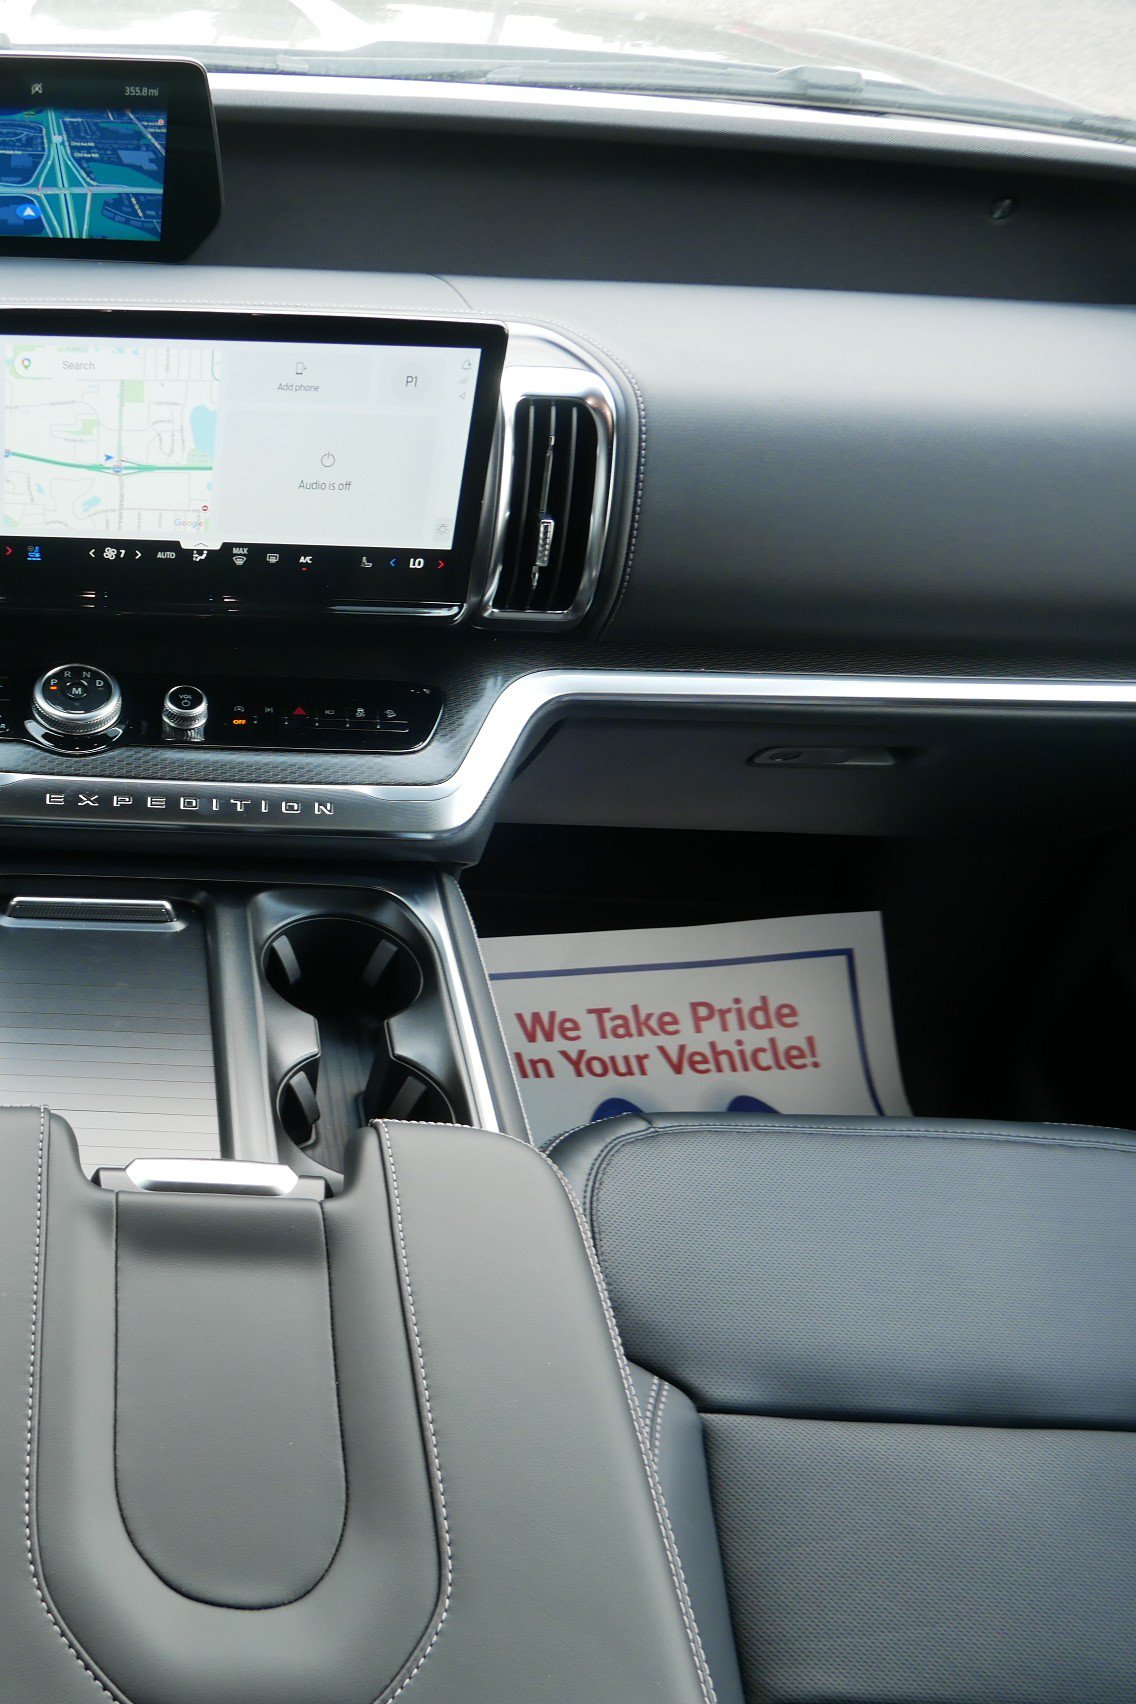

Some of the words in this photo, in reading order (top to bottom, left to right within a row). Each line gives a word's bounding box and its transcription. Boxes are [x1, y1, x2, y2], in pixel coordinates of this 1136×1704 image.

[124, 86, 148, 96] 355.8
[148, 88, 159, 96] mi
[62, 360, 96, 370] Search
[405, 375, 419, 388] P1
[277, 382, 294, 392] Add
[294, 382, 320, 393] phone
[298, 479, 327, 491] Audio
[327, 481, 336, 491] is
[337, 480, 352, 492] off
[174, 517, 204, 529] Google
[119, 549, 126, 558] 7
[156, 551, 176, 560] AUTO
[232, 547, 249, 555] MAX
[299, 555, 313, 564] A/C
[409, 557, 425, 569] LO
[50, 678, 58, 686] P
[95, 679, 104, 687] D
[71, 687, 82, 695] M
[45, 792, 336, 815] EXPEDITION
[515, 1009, 582, 1043] We
[586, 1004, 681, 1040] Take
[689, 995, 800, 1034] Pride
[514, 1050, 555, 1079] In
[557, 1046, 651, 1078] Your
[656, 1034, 822, 1075] Vehicle!
